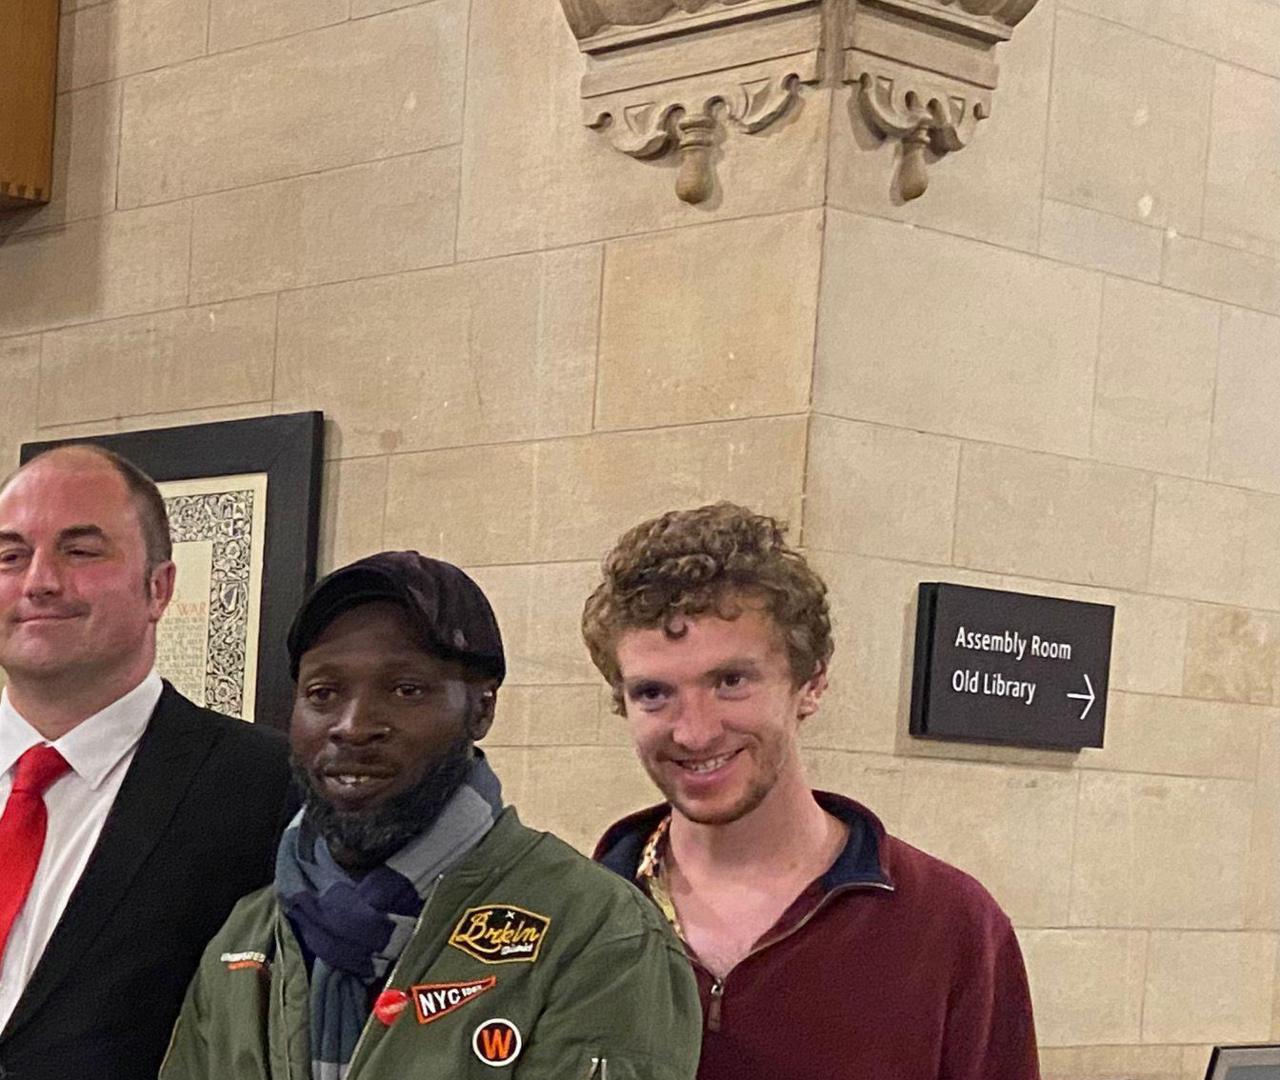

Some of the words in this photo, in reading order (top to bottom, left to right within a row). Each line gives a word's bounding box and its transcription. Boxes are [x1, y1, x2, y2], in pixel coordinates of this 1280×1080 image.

[955, 626, 1027, 660] Assembly
[1031, 635, 1072, 660] Room
[952, 669, 979, 693] Old
[983, 672, 1036, 705] Library
[419, 988, 460, 1016] NYC
[482, 1028, 512, 1059] W
